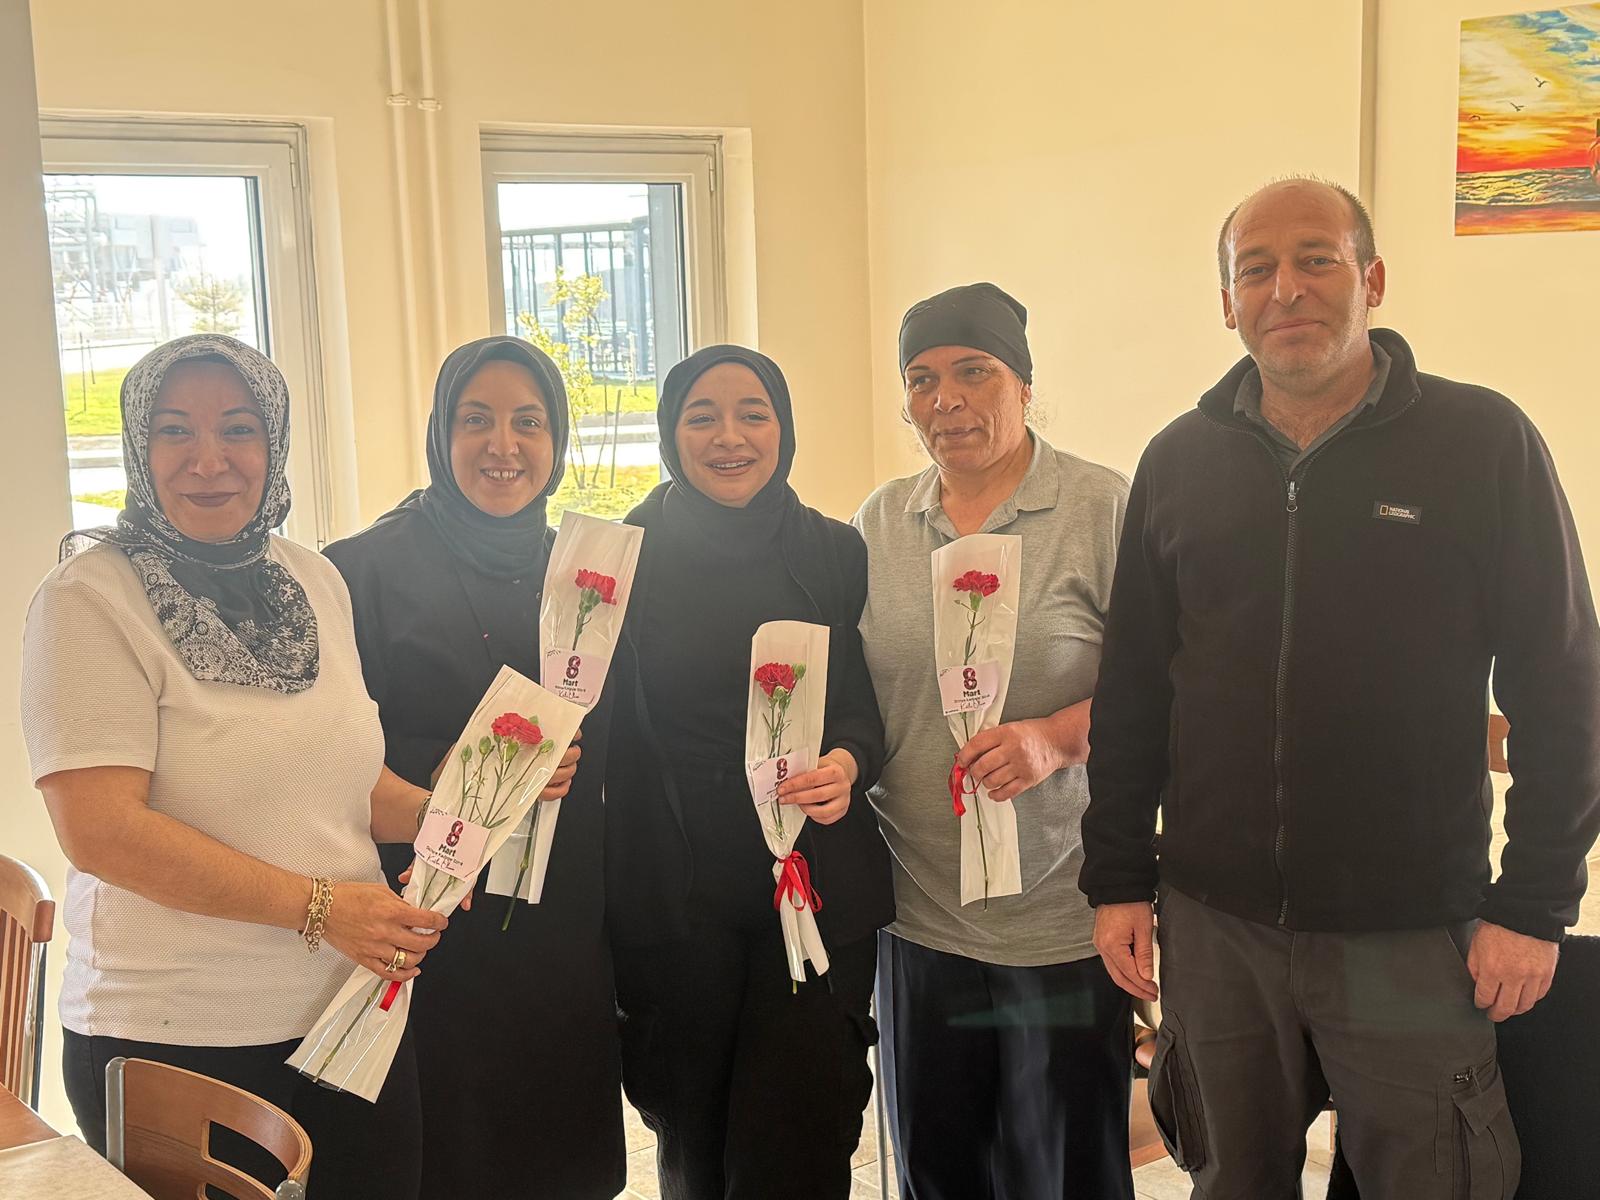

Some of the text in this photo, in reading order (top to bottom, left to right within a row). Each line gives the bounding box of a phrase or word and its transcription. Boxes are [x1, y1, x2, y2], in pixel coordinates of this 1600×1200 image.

[566, 655, 581, 679] 8
[563, 679, 578, 687] Mart
[963, 667, 977, 690] 8
[776, 758, 788, 779] 8
[446, 820, 463, 847] 8
[438, 844, 457, 857] Mart
